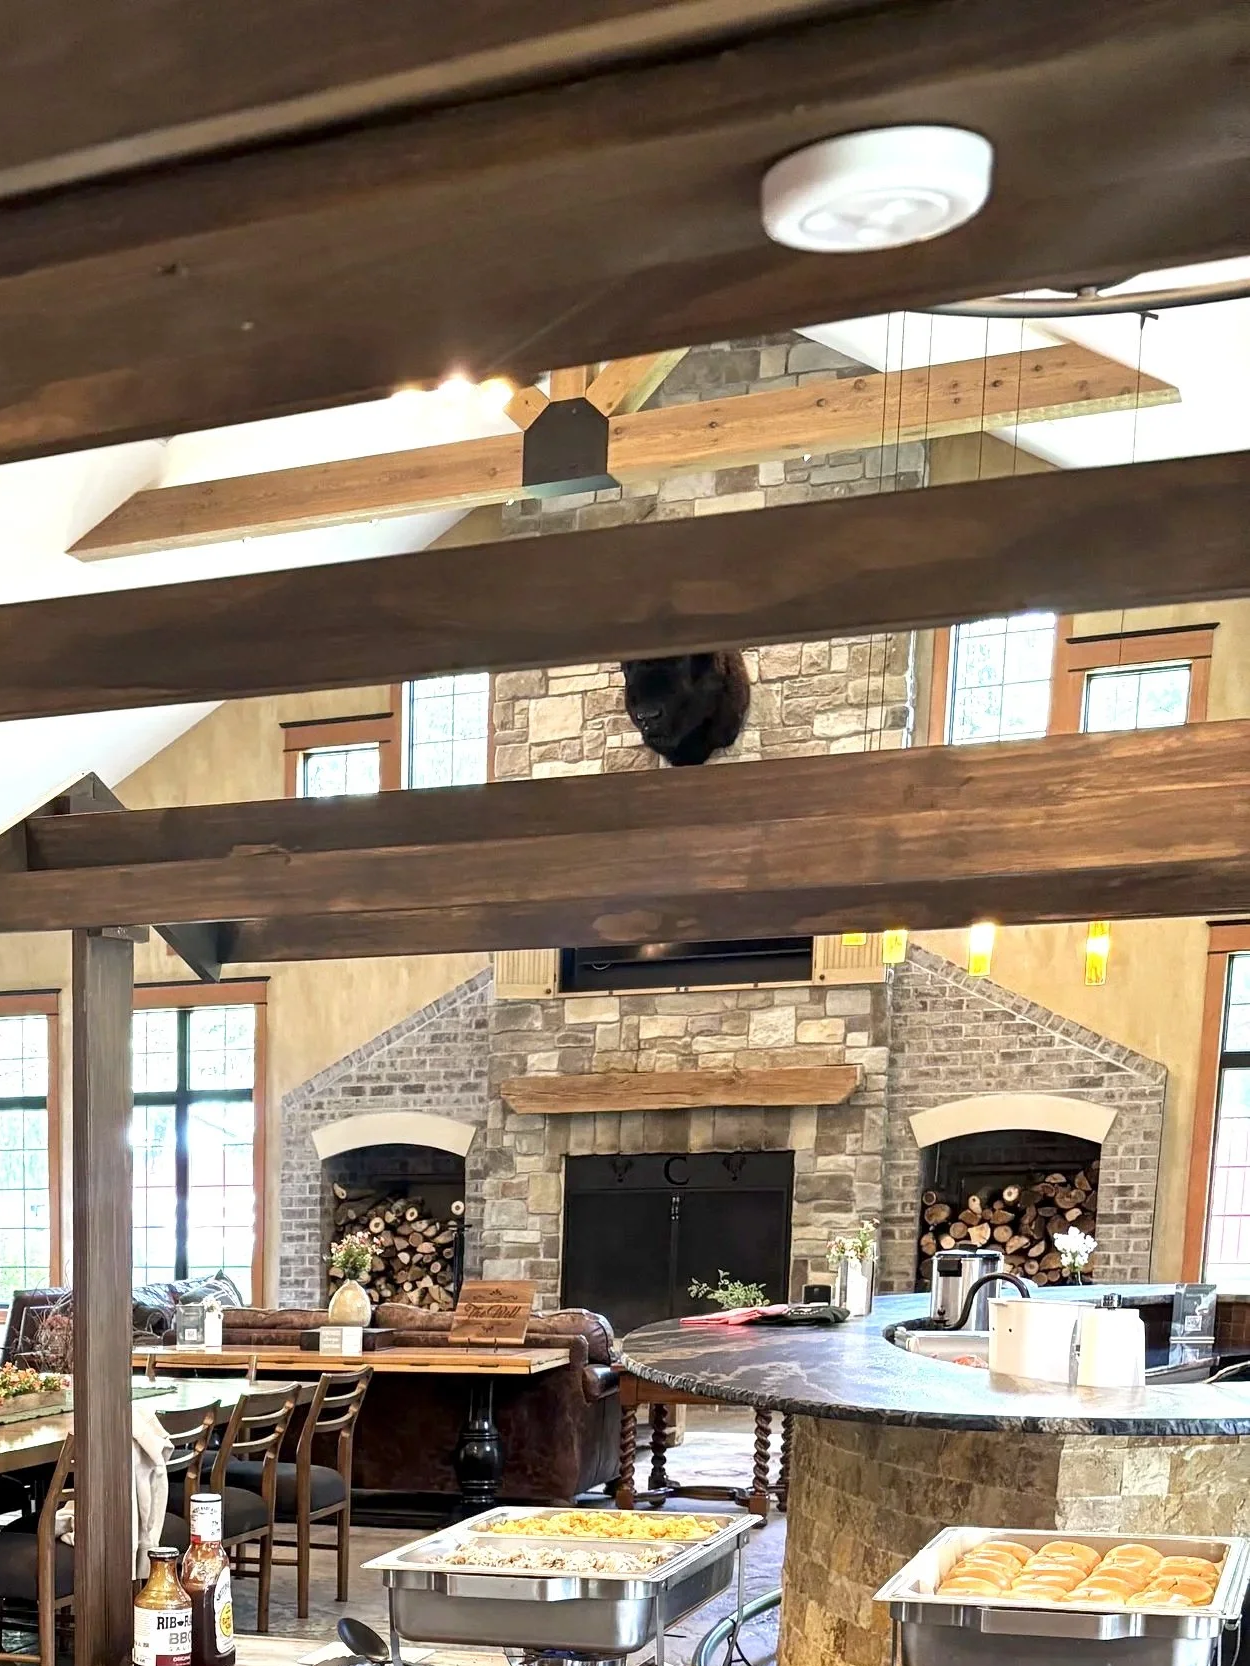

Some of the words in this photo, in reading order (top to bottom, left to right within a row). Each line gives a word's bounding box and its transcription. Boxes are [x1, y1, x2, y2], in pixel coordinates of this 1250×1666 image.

[664, 1156, 690, 1186] C
[464, 1302, 486, 1319] The
[487, 1304, 522, 1319] Well
[157, 1616, 177, 1630] RIB
[169, 1631, 192, 1645] BB
